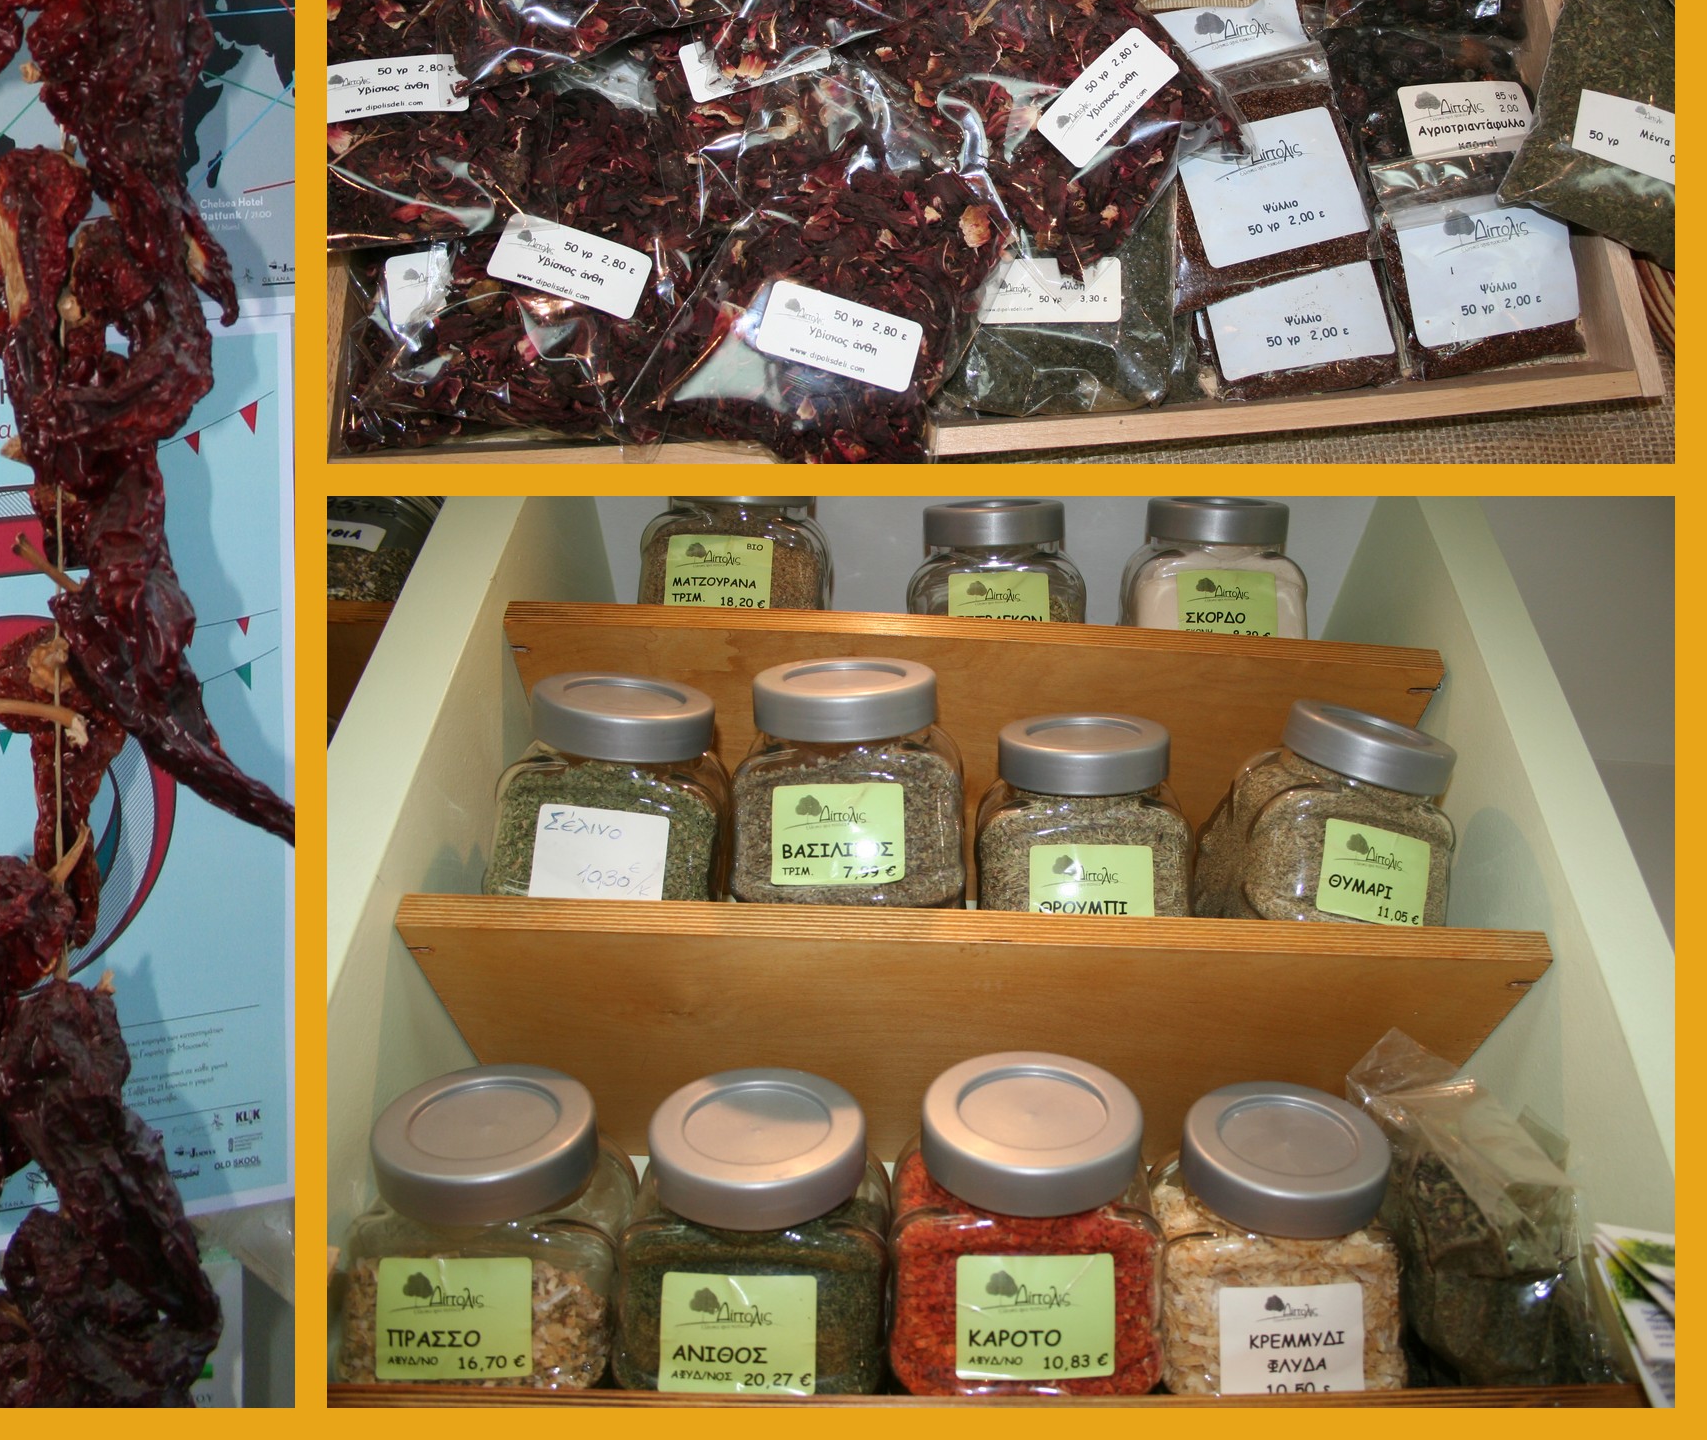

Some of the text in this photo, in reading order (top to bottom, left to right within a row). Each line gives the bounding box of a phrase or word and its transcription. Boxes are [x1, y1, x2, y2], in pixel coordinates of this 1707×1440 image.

[1418, 118, 1526, 138] Αγριοτριαντάφυλλο
[1589, 129, 1671, 147] 50 Μέντα
[238, 196, 263, 206] Hotel
[1263, 200, 1298, 214] Ψύλλιο
[1248, 224, 1263, 236] 50
[1479, 281, 1517, 295] Ψύλλιο
[671, 576, 757, 590] ΜΑΤΖΟΥΡΑΝΑ
[671, 591, 706, 604] ΤΡΙΜ.
[1185, 612, 1246, 625] ΣΚΟΡΔΟ
[543, 811, 622, 841] Σέλινο
[781, 841, 895, 860] ΒΑΣΙΛΙΣ
[782, 866, 813, 878] ΤΡΙΜ.
[1327, 873, 1393, 901] ΘΥΜΑΡΙ
[387, 1328, 482, 1349] ΠΡΑΣΣΟ
[969, 1329, 1061, 1347] ΚΑΡΟΤΟ
[1249, 1330, 1345, 1349] ΚΡΕΜΜΥΔΙ
[672, 1345, 768, 1365] ΑΝΙΘΟΣ
